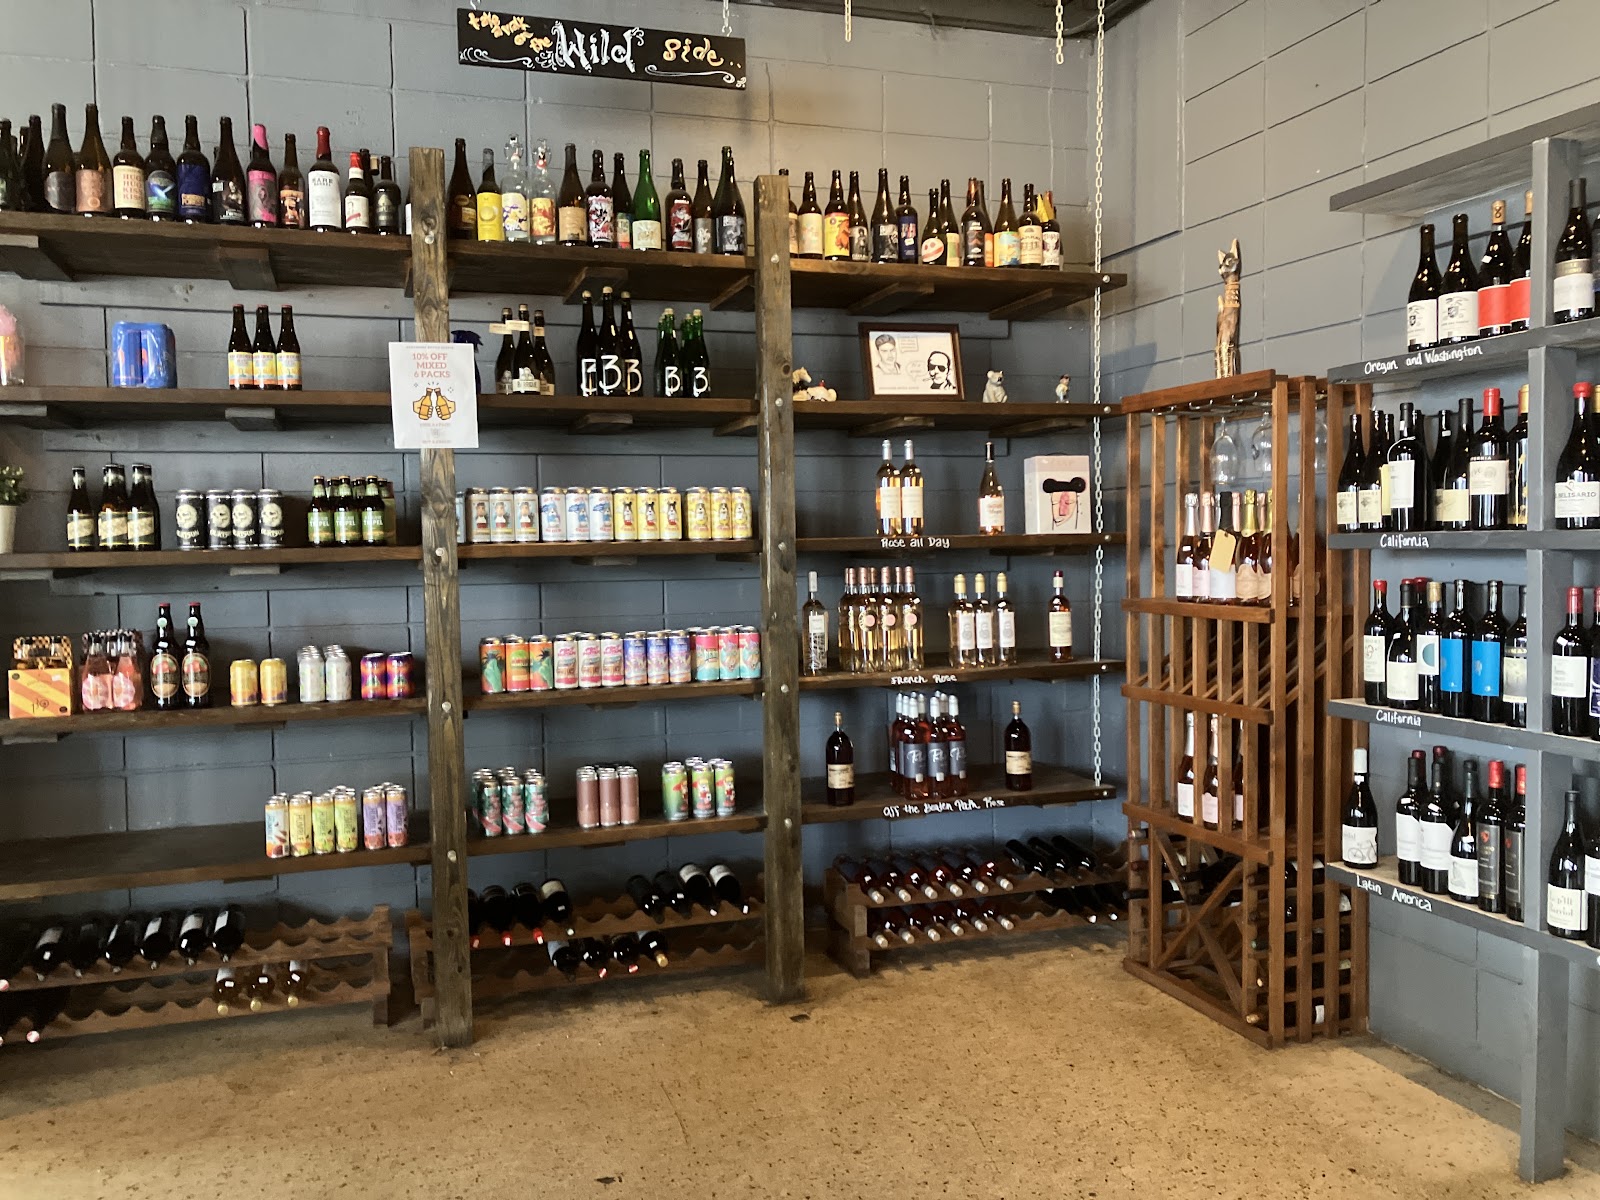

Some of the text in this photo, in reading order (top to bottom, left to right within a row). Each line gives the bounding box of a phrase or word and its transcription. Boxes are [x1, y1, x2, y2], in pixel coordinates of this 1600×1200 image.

[412, 352, 448, 361] 10% OFF
[1364, 345, 1483, 375] Oregon and Washington
[416, 361, 447, 369] MIXED
[414, 370, 451, 378] 6 PACKS
[310, 519, 330, 527] TPEL
[881, 536, 950, 549] Rose all Day
[1380, 534, 1429, 548] California
[1376, 710, 1421, 726] California
[903, 804, 920, 814] the
[983, 796, 1006, 808] Rose
[1356, 874, 1433, 912] Latin America
